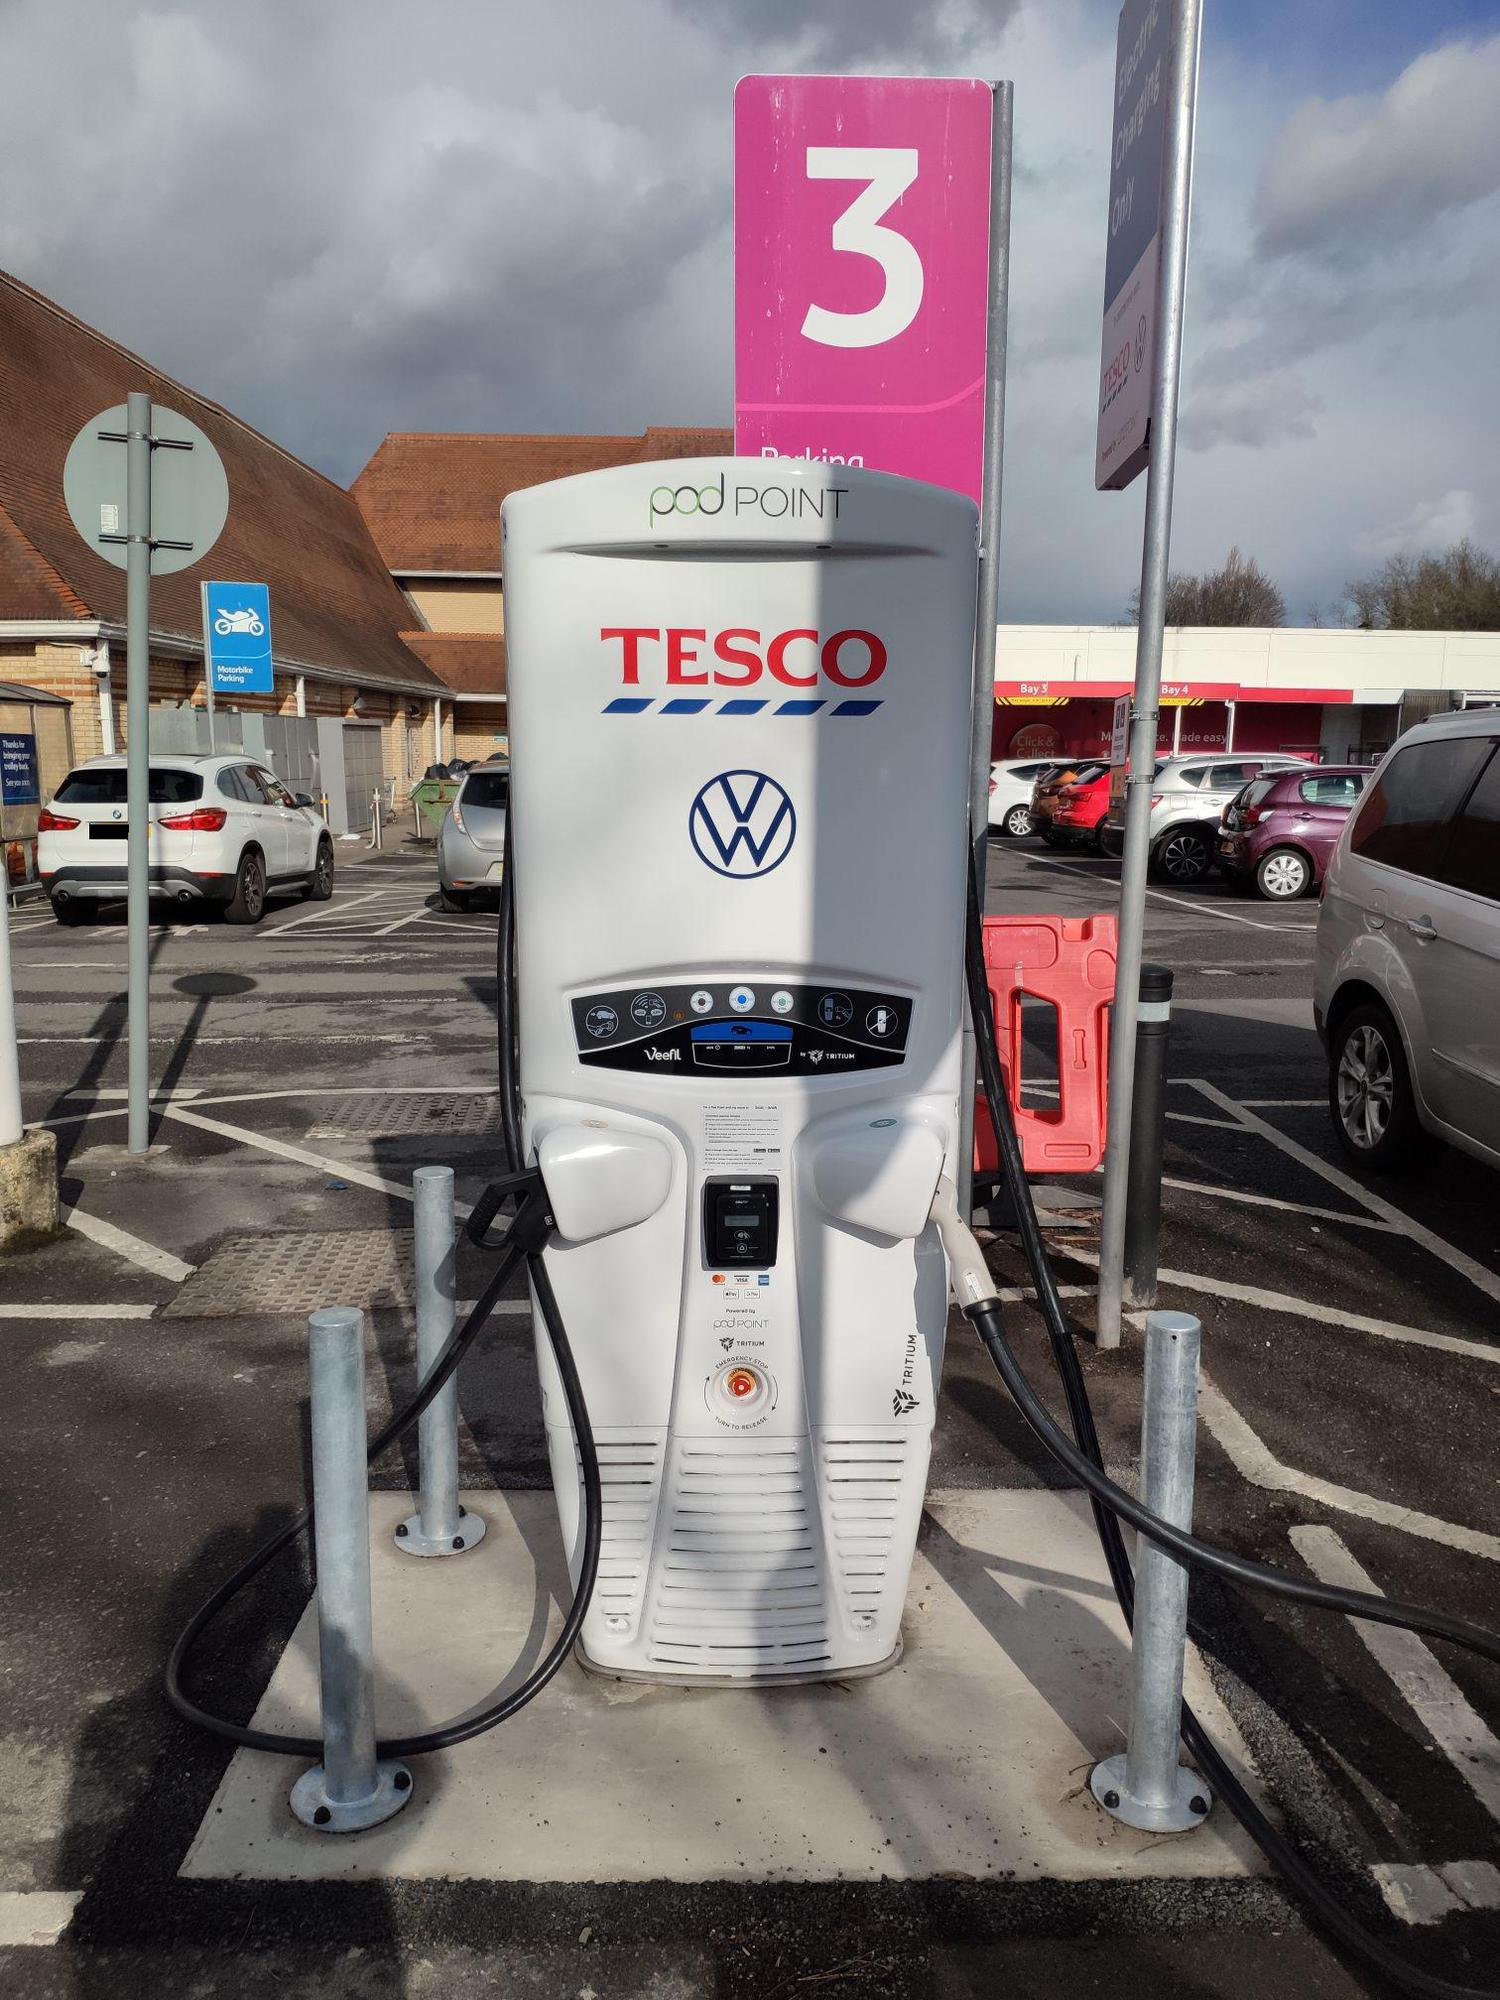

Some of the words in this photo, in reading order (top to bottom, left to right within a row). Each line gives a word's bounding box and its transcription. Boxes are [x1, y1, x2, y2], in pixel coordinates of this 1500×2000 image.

[1114, 55, 1161, 170] Charging
[1111, 176, 1135, 237] Only
[801, 146, 924, 348] 3
[1103, 342, 1130, 399] TESCO
[760, 446, 864, 468] Pking
[650, 472, 725, 529] pod
[735, 486, 849, 519] POINT
[600, 627, 888, 688] TESCO
[217, 665, 254, 674] Motorbike
[217, 673, 245, 684] Parking
[1020, 683, 1039, 695] Bay
[1041, 683, 1048, 693] 3
[1161, 684, 1181, 696] Bay
[1182, 684, 1189, 694] 4
[1017, 736, 1044, 746] Click
[1046, 736, 1056, 746] &
[1016, 748, 1056, 759] Cllect
[644, 1046, 682, 1061] Veefil
[713, 1316, 735, 1330] pod
[737, 1319, 769, 1329] POINT
[715, 1355, 753, 1369] EMERGENCY
[754, 1358, 769, 1369] STOP
[902, 1334, 917, 1385] TRITIUM
[714, 1416, 730, 1428] TURN
[742, 1416, 768, 1430] RELEASE
